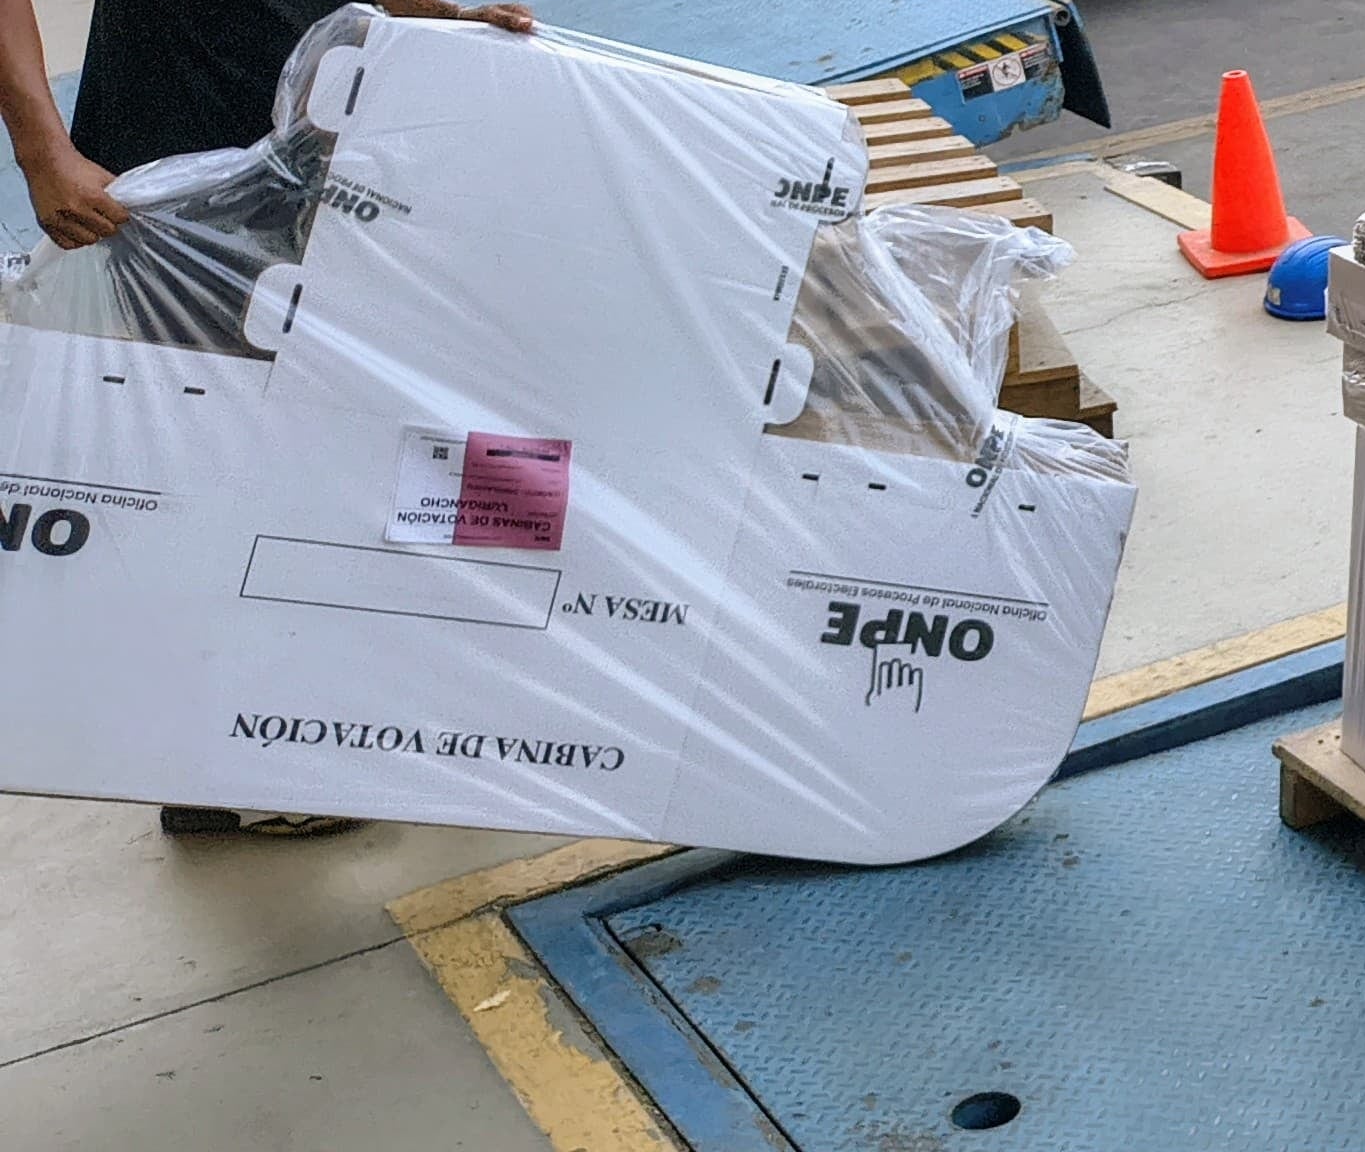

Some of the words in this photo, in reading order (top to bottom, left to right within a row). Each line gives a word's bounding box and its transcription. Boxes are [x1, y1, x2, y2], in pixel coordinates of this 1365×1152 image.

[23, 484, 97, 505] Nacional
[101, 493, 158, 512] Oficina
[419, 496, 509, 511] LURIGANCHO
[397, 511, 467, 526] VOTACIÓN
[470, 514, 490, 527] DE
[492, 516, 552, 532] CABINAS
[0, 503, 91, 558] ON
[786, 576, 859, 598] Electorales
[860, 587, 920, 607] Procesos
[605, 595, 690, 625] MESA
[922, 595, 940, 609] de
[941, 597, 1001, 616] Nacional
[1003, 604, 1048, 622] Oficina
[820, 601, 995, 663] ONPE
[229, 712, 425, 754] VOTACIÓN
[436, 730, 488, 760] DE
[494, 736, 626, 773] CABINA
